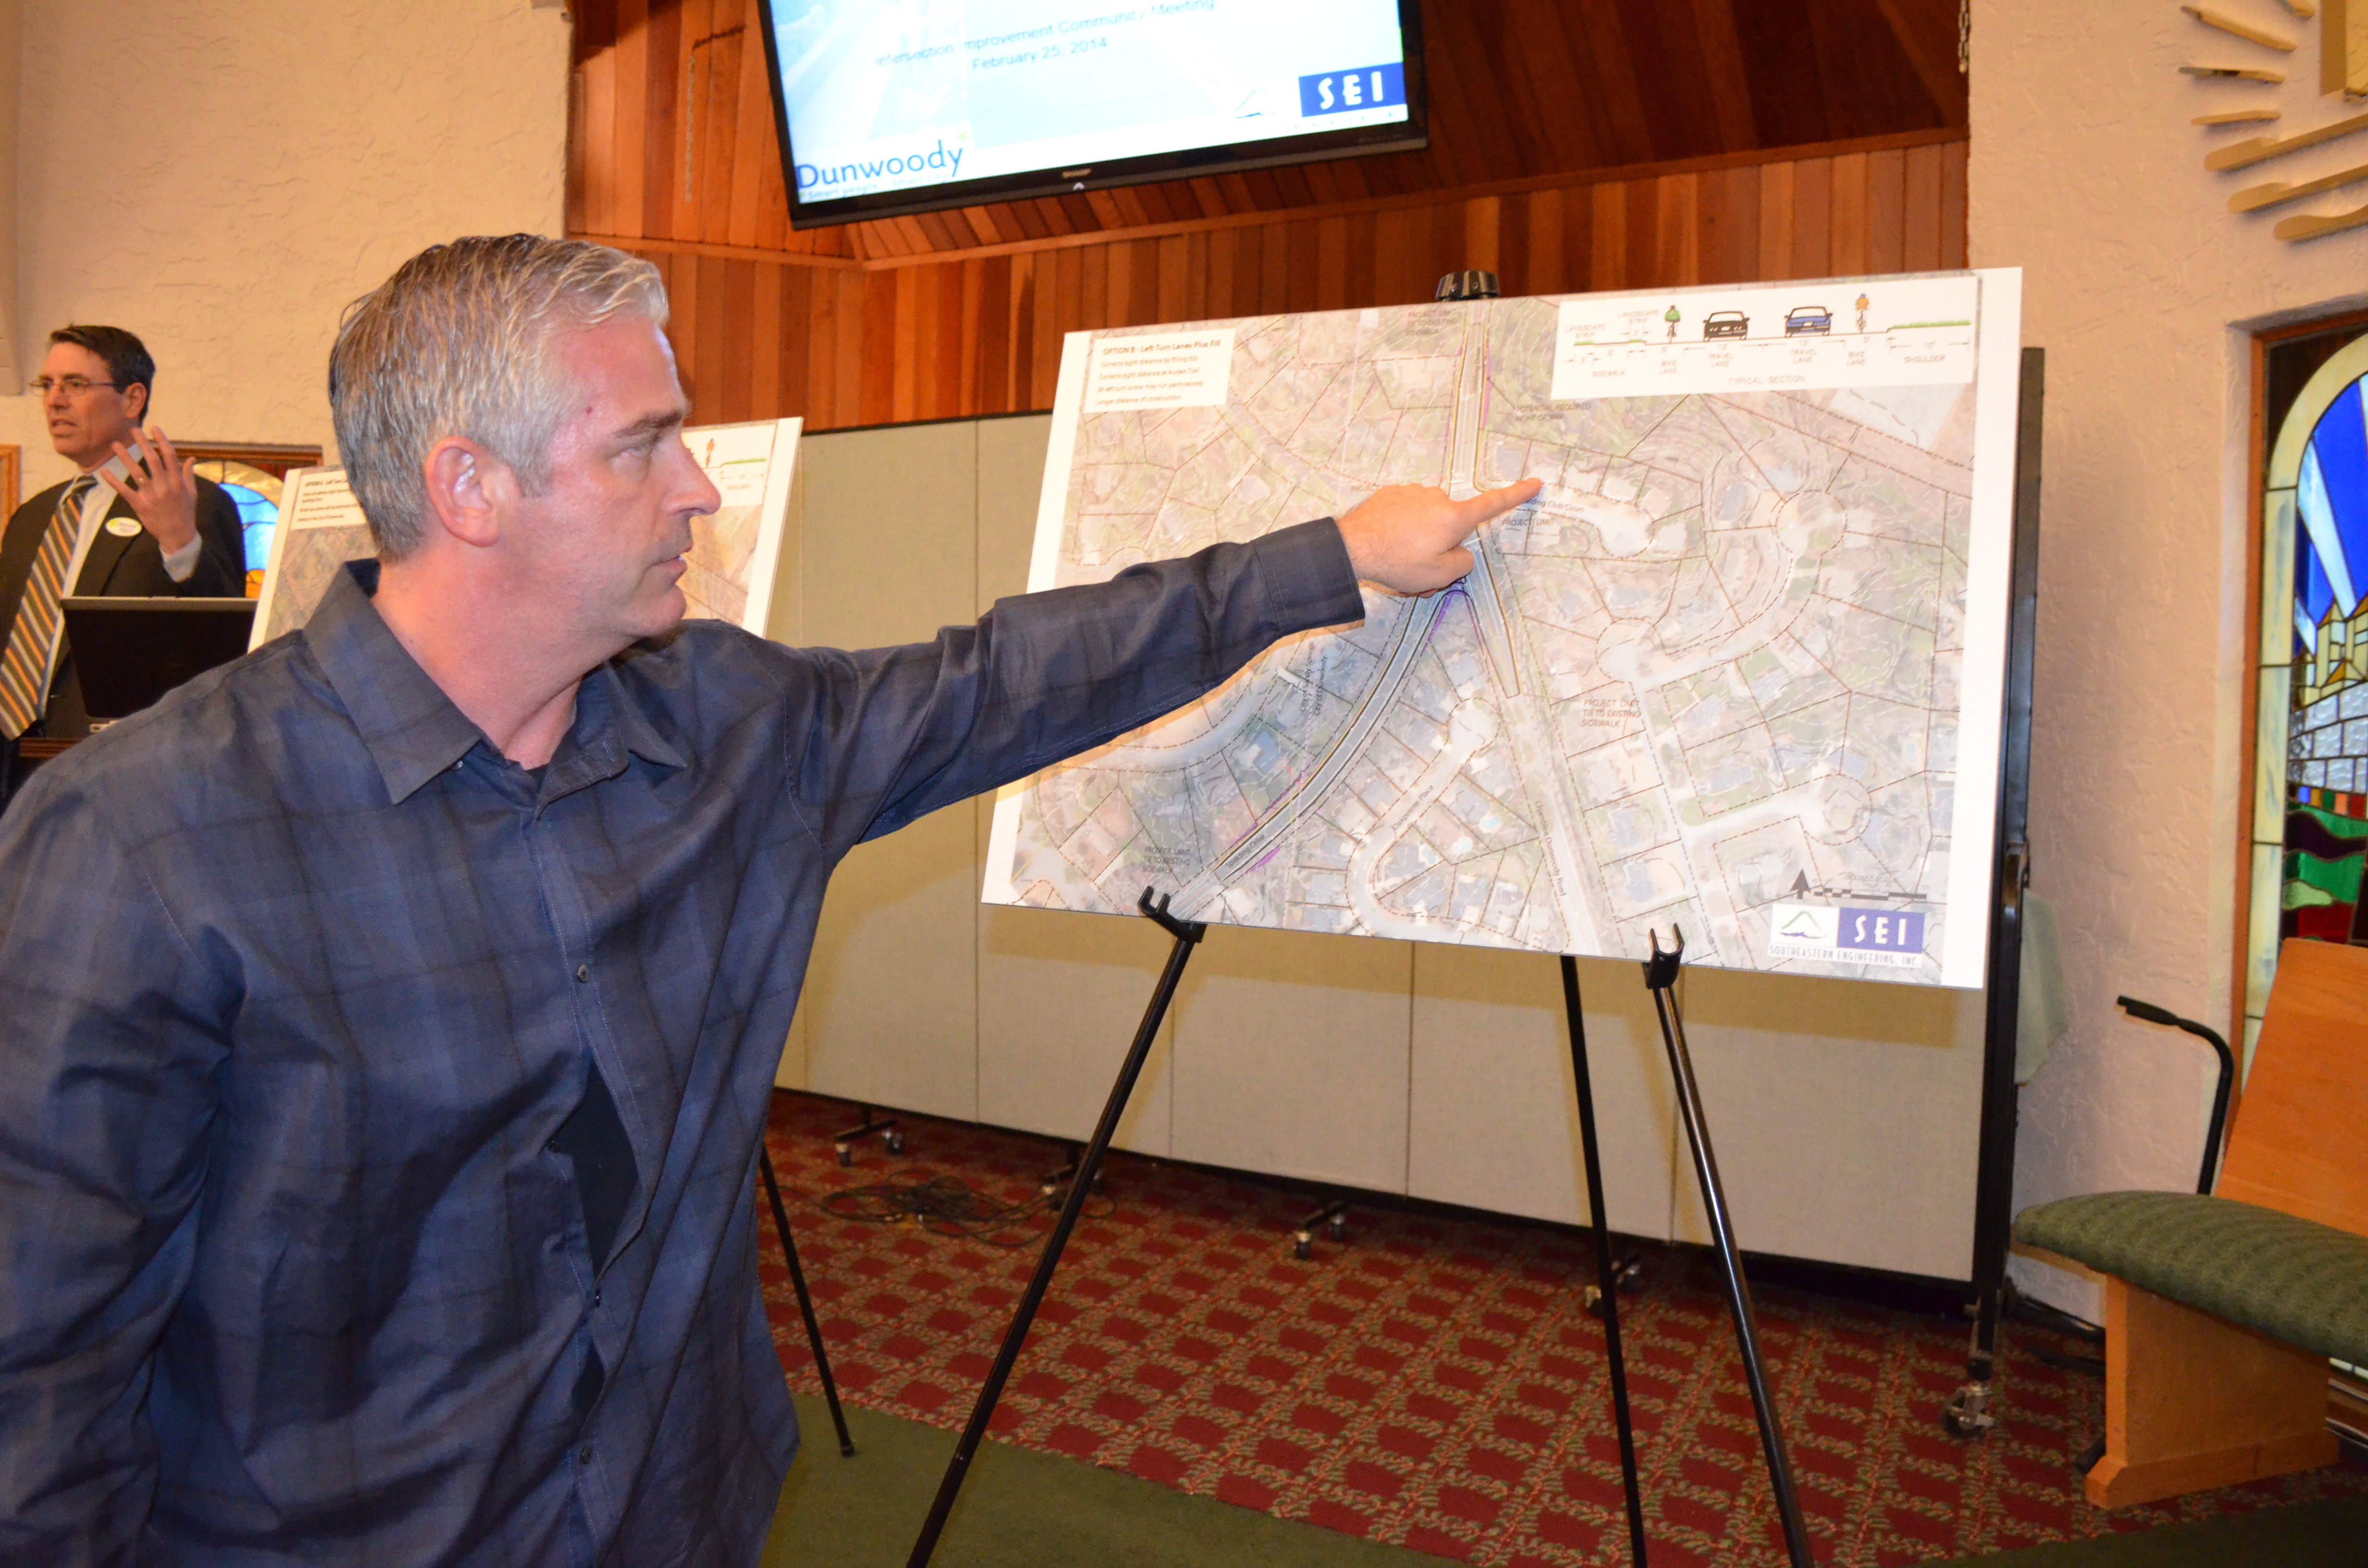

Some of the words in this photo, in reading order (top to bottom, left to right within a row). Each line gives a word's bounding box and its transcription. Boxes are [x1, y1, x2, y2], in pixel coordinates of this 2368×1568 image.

[875, 44, 954, 66] Intersection
[959, 25, 1053, 50] Improvement
[1058, 10, 1145, 33] Community
[1151, 0, 1214, 17] Meeting
[972, 51, 1036, 70] February
[1042, 45, 1065, 59] 25,
[1069, 37, 1107, 54] 2014
[1318, 71, 1383, 110] SEI
[796, 139, 962, 188] Dunwoody
[1618, 310, 1660, 318] LANDSCAPE
[1565, 323, 1606, 332] LANDSCAPE
[1904, 355, 1946, 364] SHOULDER
[1728, 377, 1763, 385] TYPICAL
[1768, 375, 1805, 384] SECTION
[1548, 501, 1563, 510] Club
[1565, 504, 1584, 513] Court
[1306, 642, 1315, 666] Springs
[1303, 669, 1312, 688] Sandy
[1317, 656, 1328, 692] Dunwoody
[1300, 698, 1308, 711] City
[1584, 699, 1616, 708] PROJECT
[1581, 720, 1620, 728] SIDEWALK
[1392, 800, 1420, 830] Oakpointe
[1418, 785, 1434, 801] Place
[1225, 847, 1251, 868] Spalding
[1249, 835, 1265, 848] Drive
[1536, 801, 1548, 836] Chamblee
[1545, 837, 1561, 876] Dunwoody
[1556, 877, 1566, 896] Road
[1855, 915, 1907, 945] SEI
[1769, 945, 1834, 959] SOUTHEASTERN
[1837, 948, 1898, 965] ENGINEERING,
[1902, 956, 1920, 967] INC.
